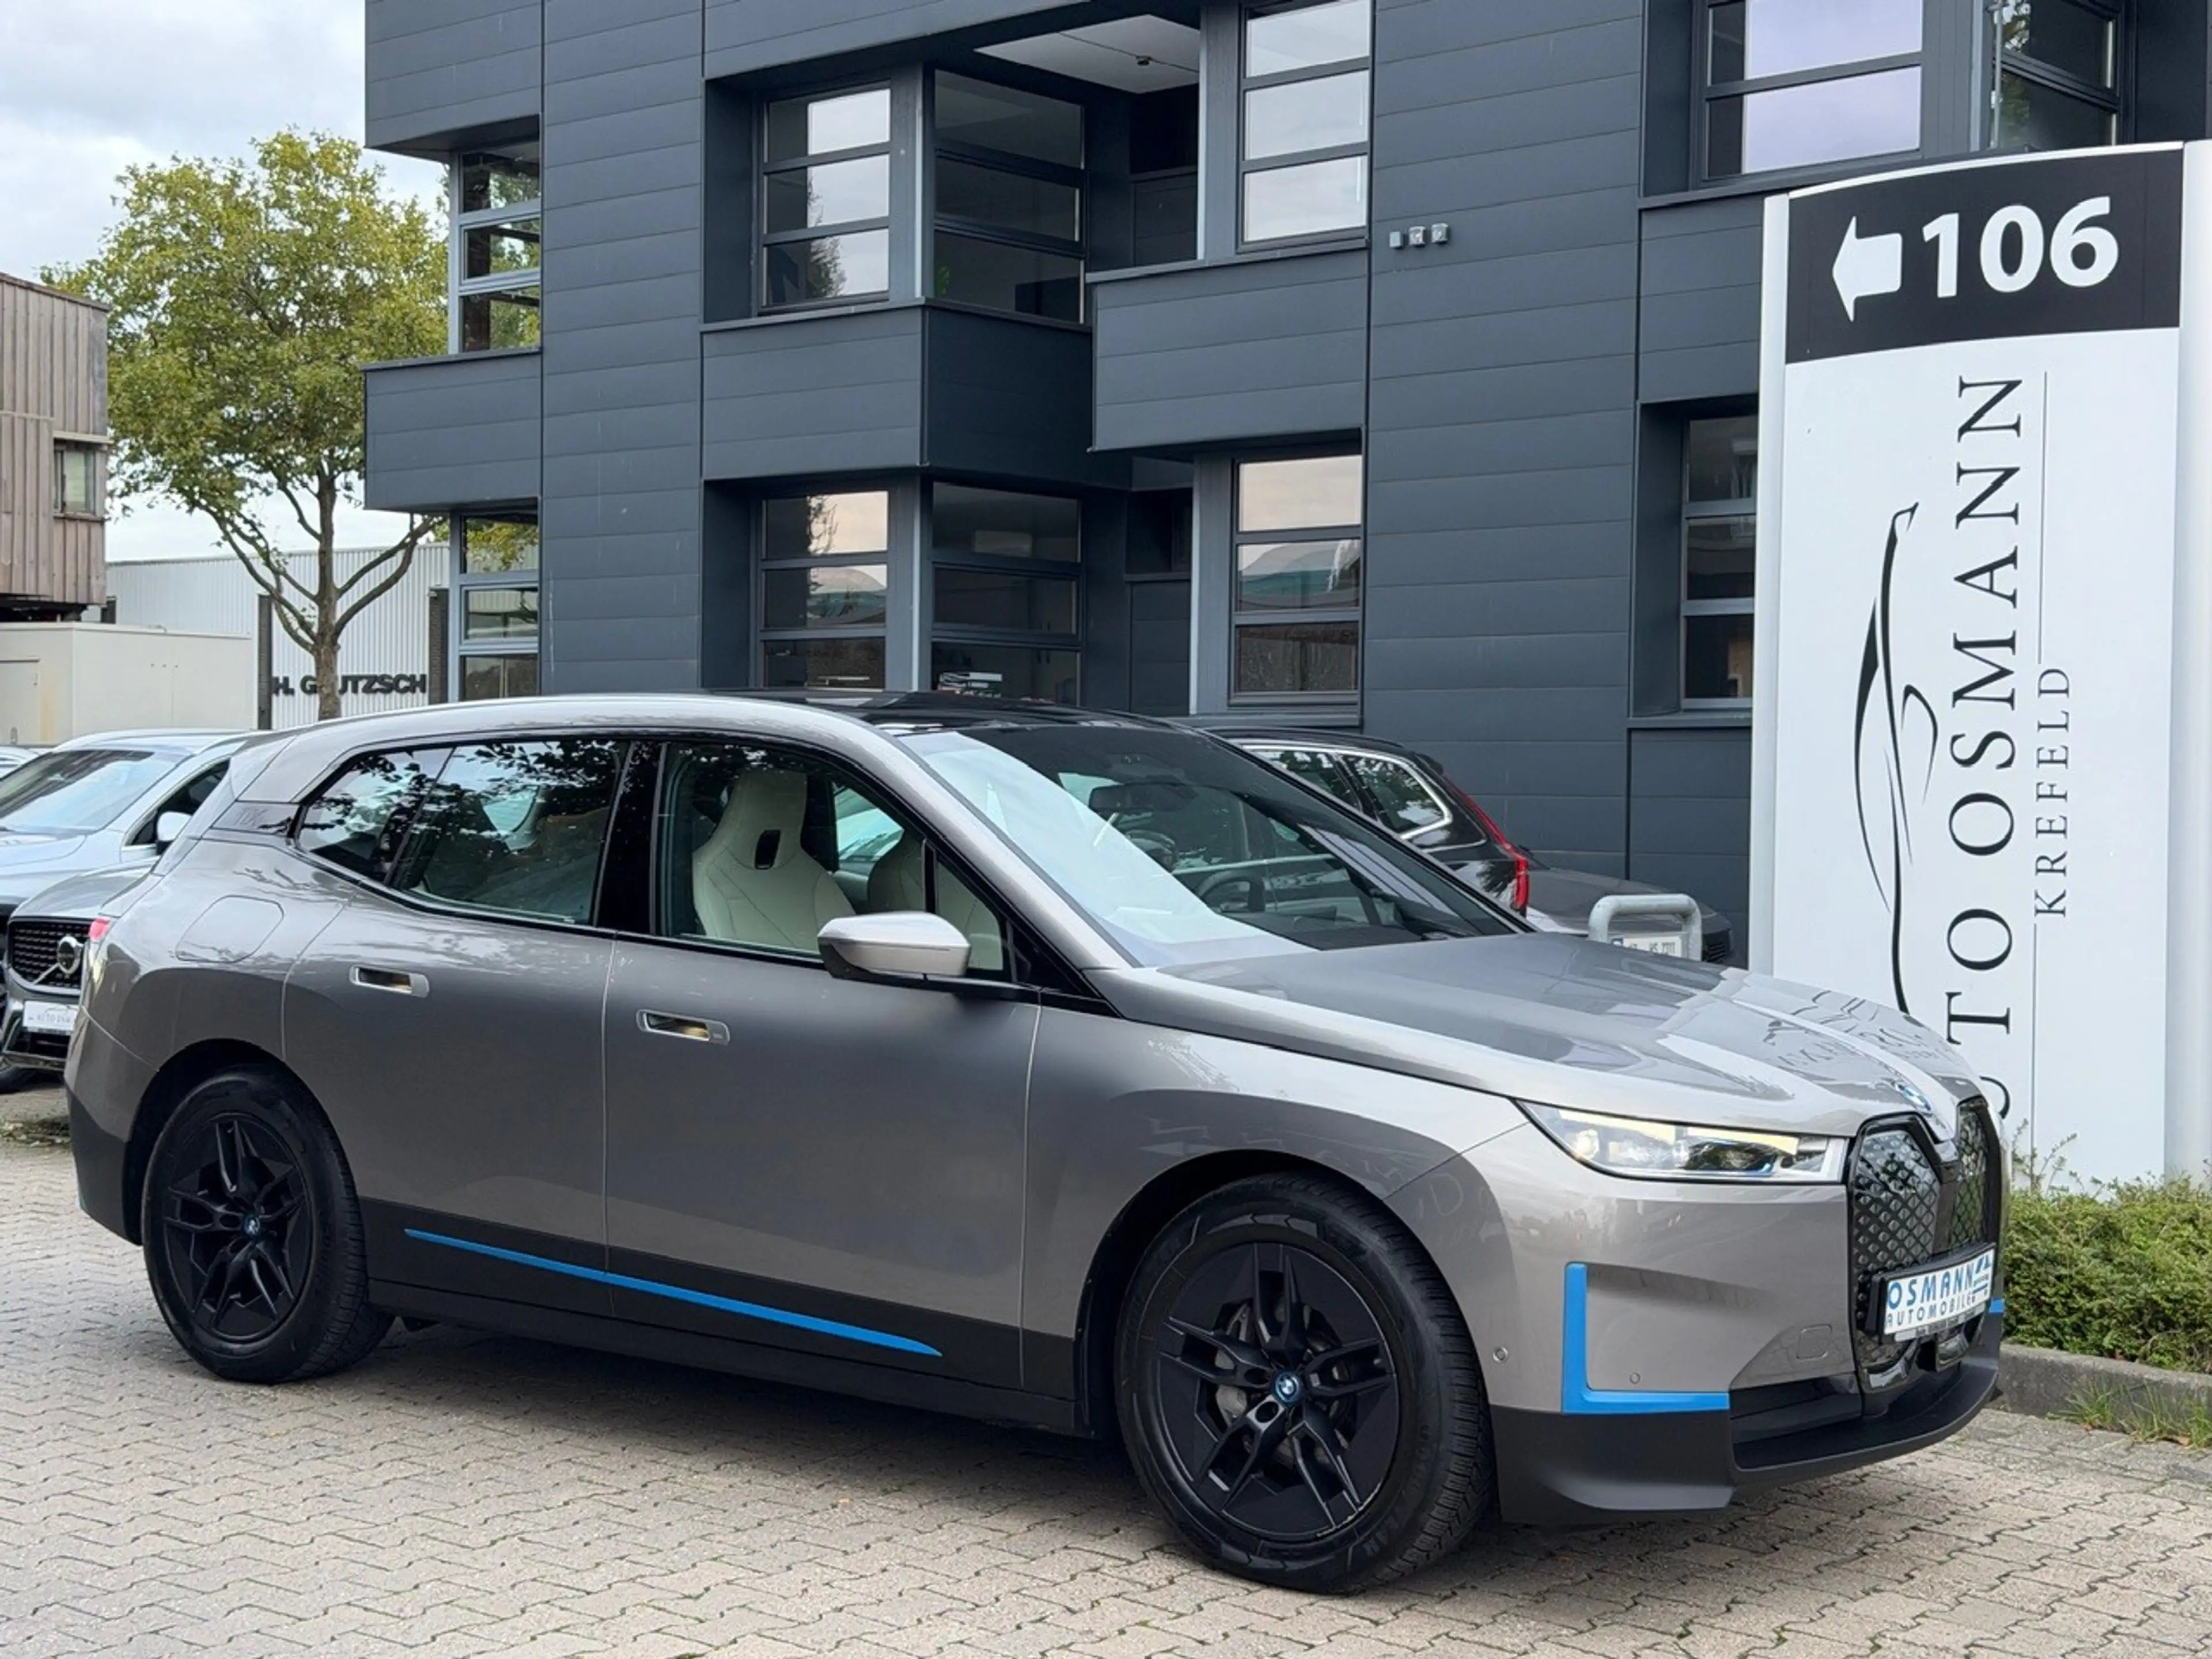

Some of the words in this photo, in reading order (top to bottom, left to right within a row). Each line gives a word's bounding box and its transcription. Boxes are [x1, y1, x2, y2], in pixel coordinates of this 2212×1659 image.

[1922, 196, 2119, 298] 106
[1949, 376, 2022, 856] OSMANN
[272, 676, 295, 696] H.
[2034, 667, 2069, 917] KREFELD
[1887, 1294, 1976, 1326] AUTOMOBILES
[1888, 1263, 1972, 1309] OSMANN
